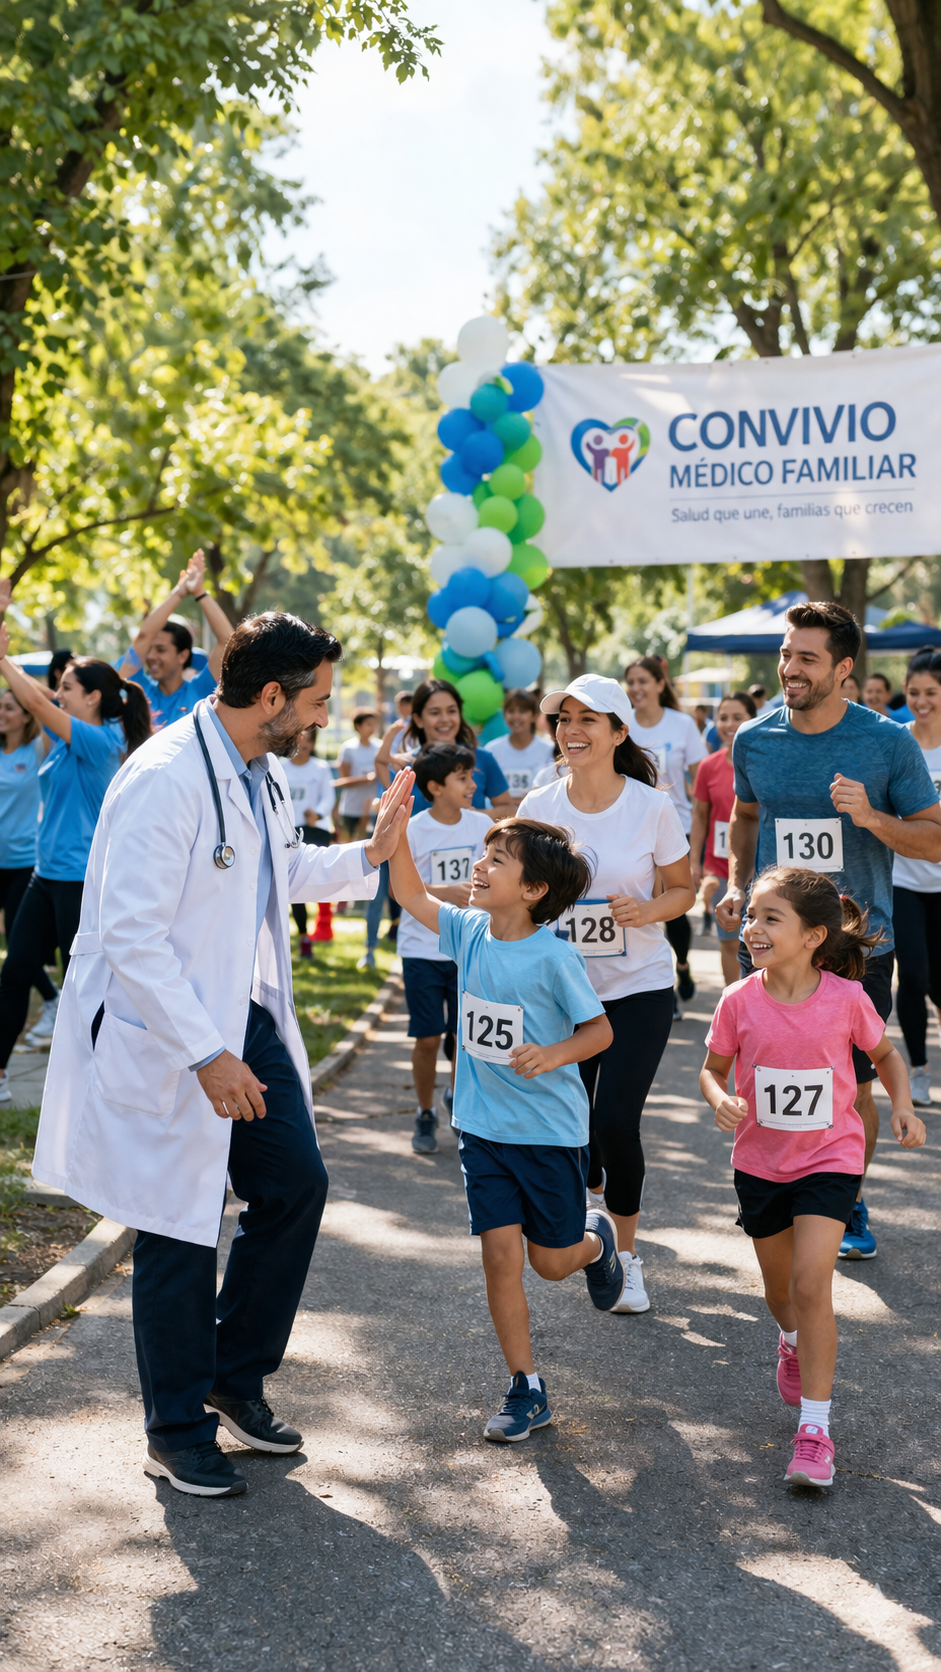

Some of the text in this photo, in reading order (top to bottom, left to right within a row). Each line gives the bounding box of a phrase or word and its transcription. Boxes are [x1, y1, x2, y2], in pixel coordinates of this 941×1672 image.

[668, 401, 897, 452] CONVIVIO
[670, 453, 917, 489] MÉDICO FAMILIAR
[671, 501, 914, 524] Salud que une, familias que crecen
[783, 832, 834, 860] 130
[437, 857, 470, 881] 137
[565, 916, 616, 943] 128
[466, 1010, 513, 1050] 125
[764, 1084, 823, 1116] 127
